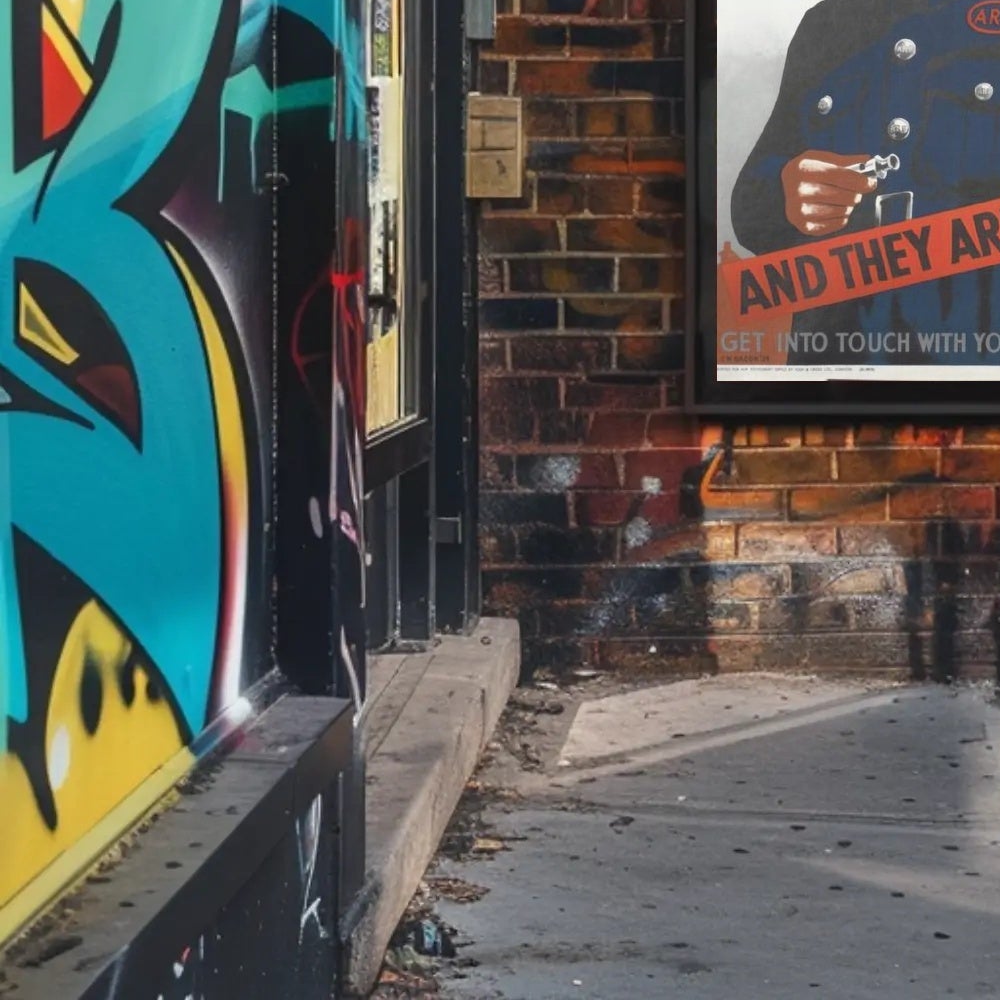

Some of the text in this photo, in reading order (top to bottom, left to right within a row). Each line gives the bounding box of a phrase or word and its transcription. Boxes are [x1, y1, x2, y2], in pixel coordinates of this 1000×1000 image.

[739, 268, 828, 315] AND
[828, 226, 931, 286] THEY
[720, 331, 766, 353] GET
[776, 331, 828, 353] INTO
[835, 331, 910, 353] TOUCH
[917, 331, 967, 353] WITH
